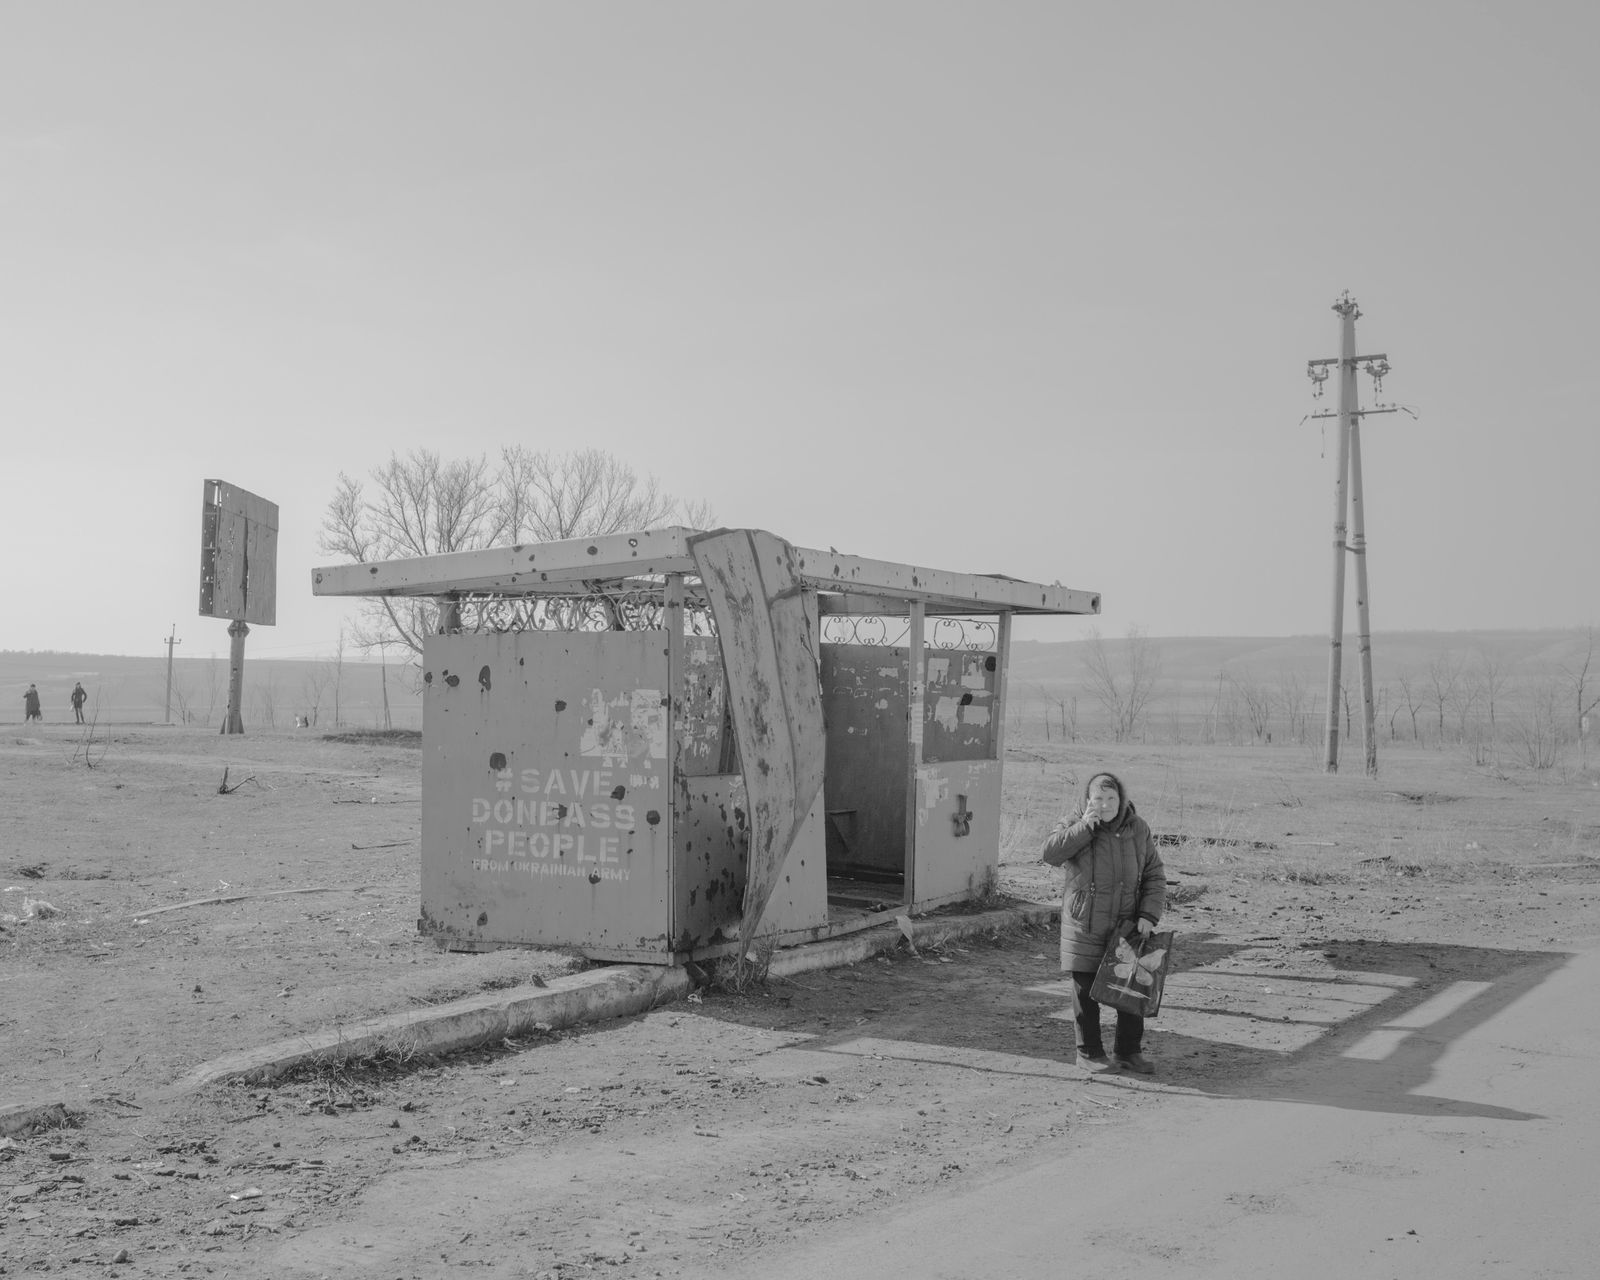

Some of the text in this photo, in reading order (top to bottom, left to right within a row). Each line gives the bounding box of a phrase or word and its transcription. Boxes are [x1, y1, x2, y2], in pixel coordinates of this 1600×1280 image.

[472, 799, 635, 829] DONBASS
[485, 830, 619, 863] PEOPLE
[472, 859, 509, 872] FROM
[591, 868, 631, 882] ARMY
